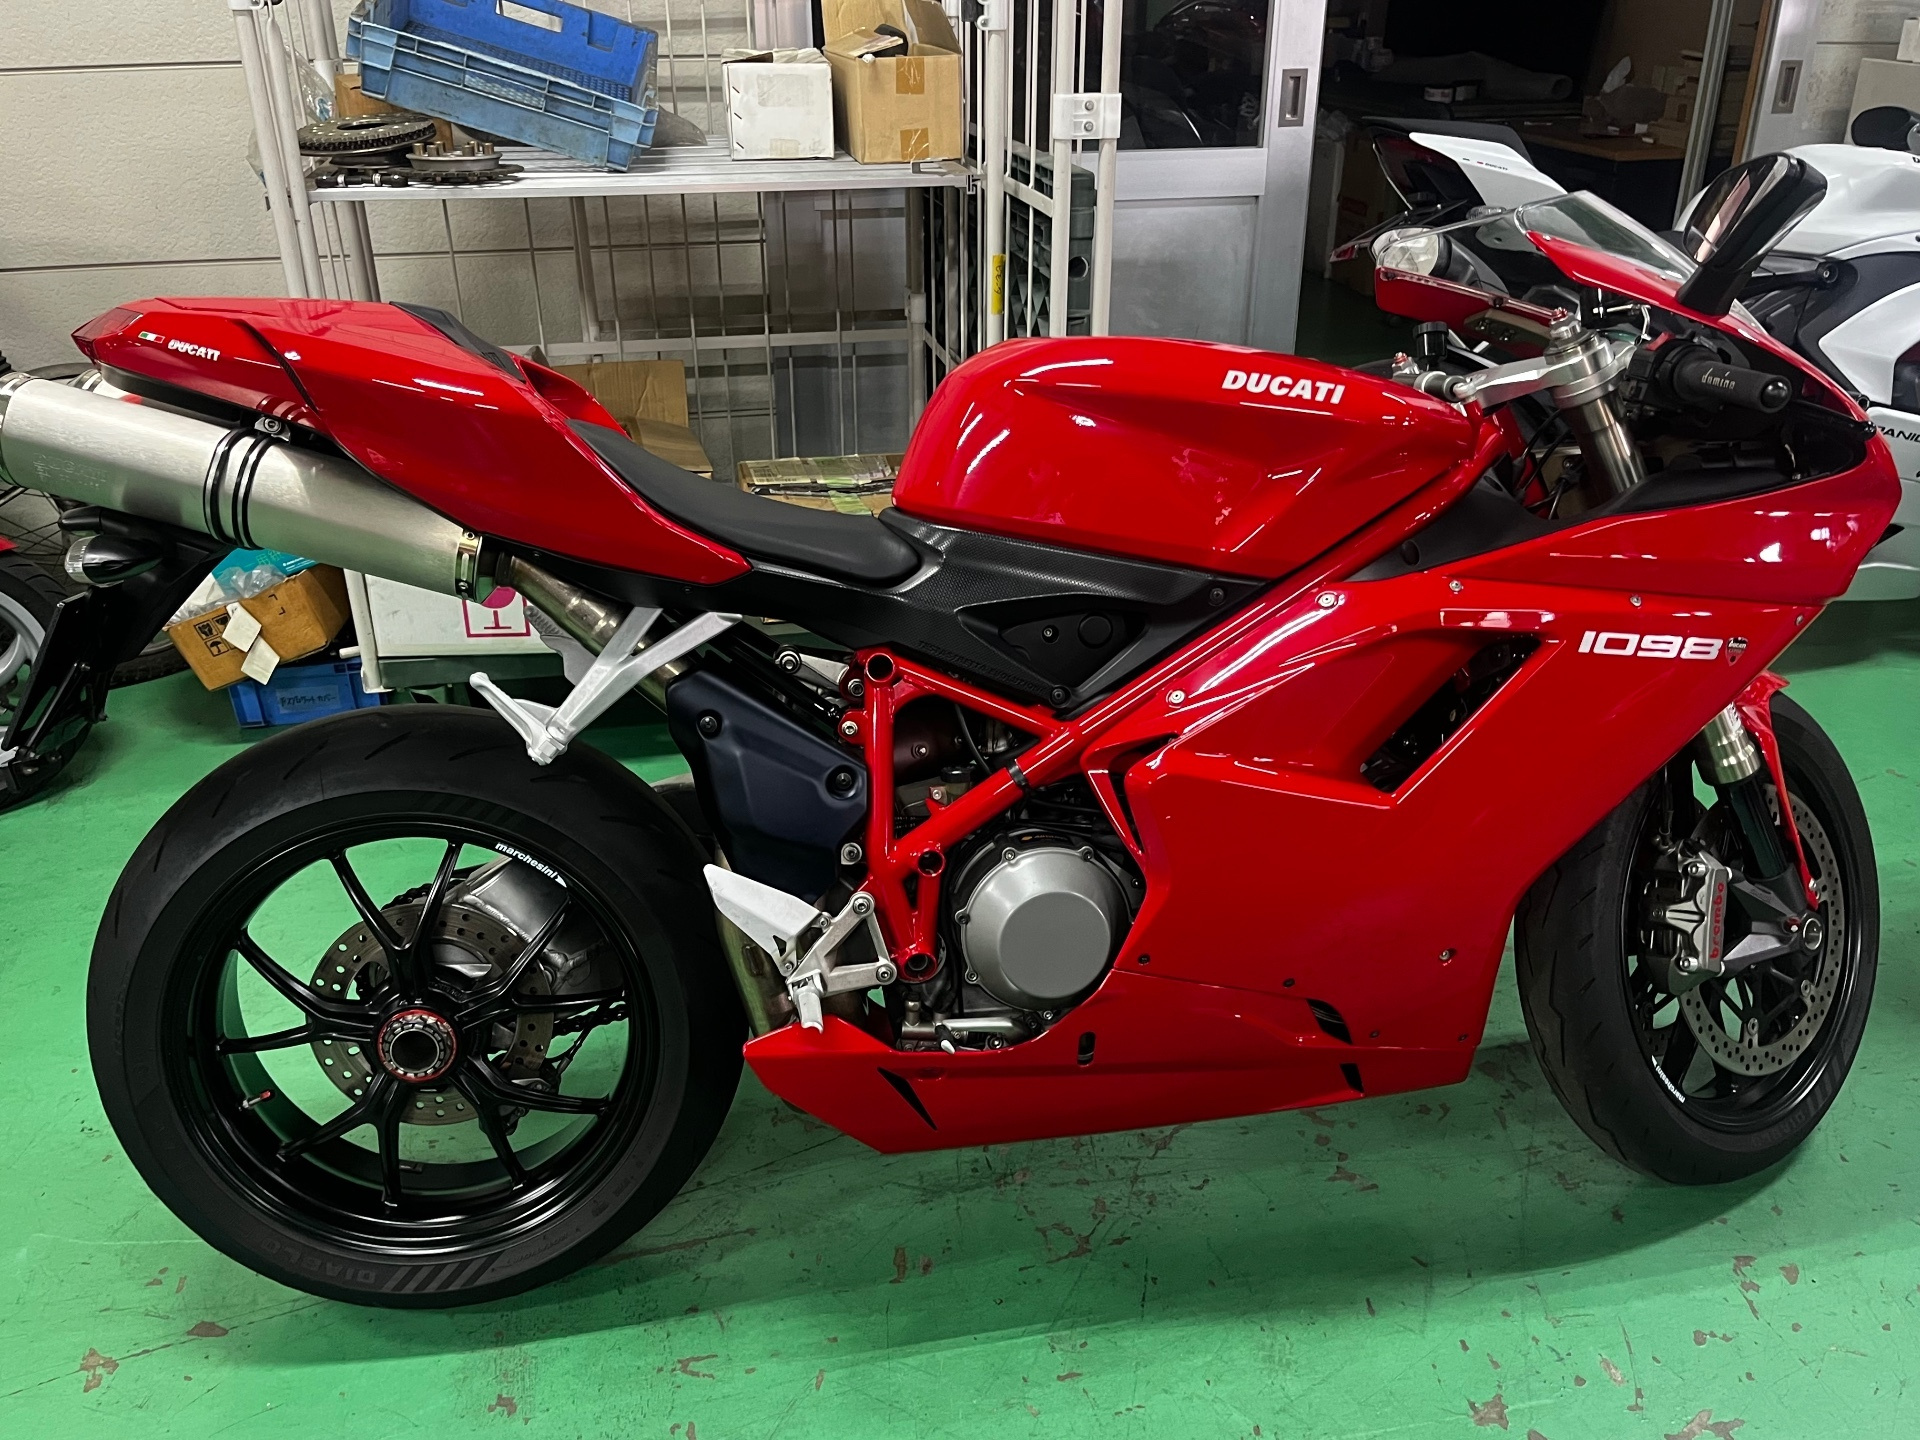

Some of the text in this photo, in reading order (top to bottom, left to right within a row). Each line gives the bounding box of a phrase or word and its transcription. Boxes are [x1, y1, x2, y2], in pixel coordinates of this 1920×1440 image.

[167, 339, 221, 362] DUCATI
[1221, 369, 1346, 405] DUCATI
[1701, 367, 1736, 390] domino
[1577, 630, 1724, 661] 1098
[494, 842, 559, 879] marchesini
[1709, 882, 1725, 959] brembo
[261, 1237, 377, 1285] DIABLO
